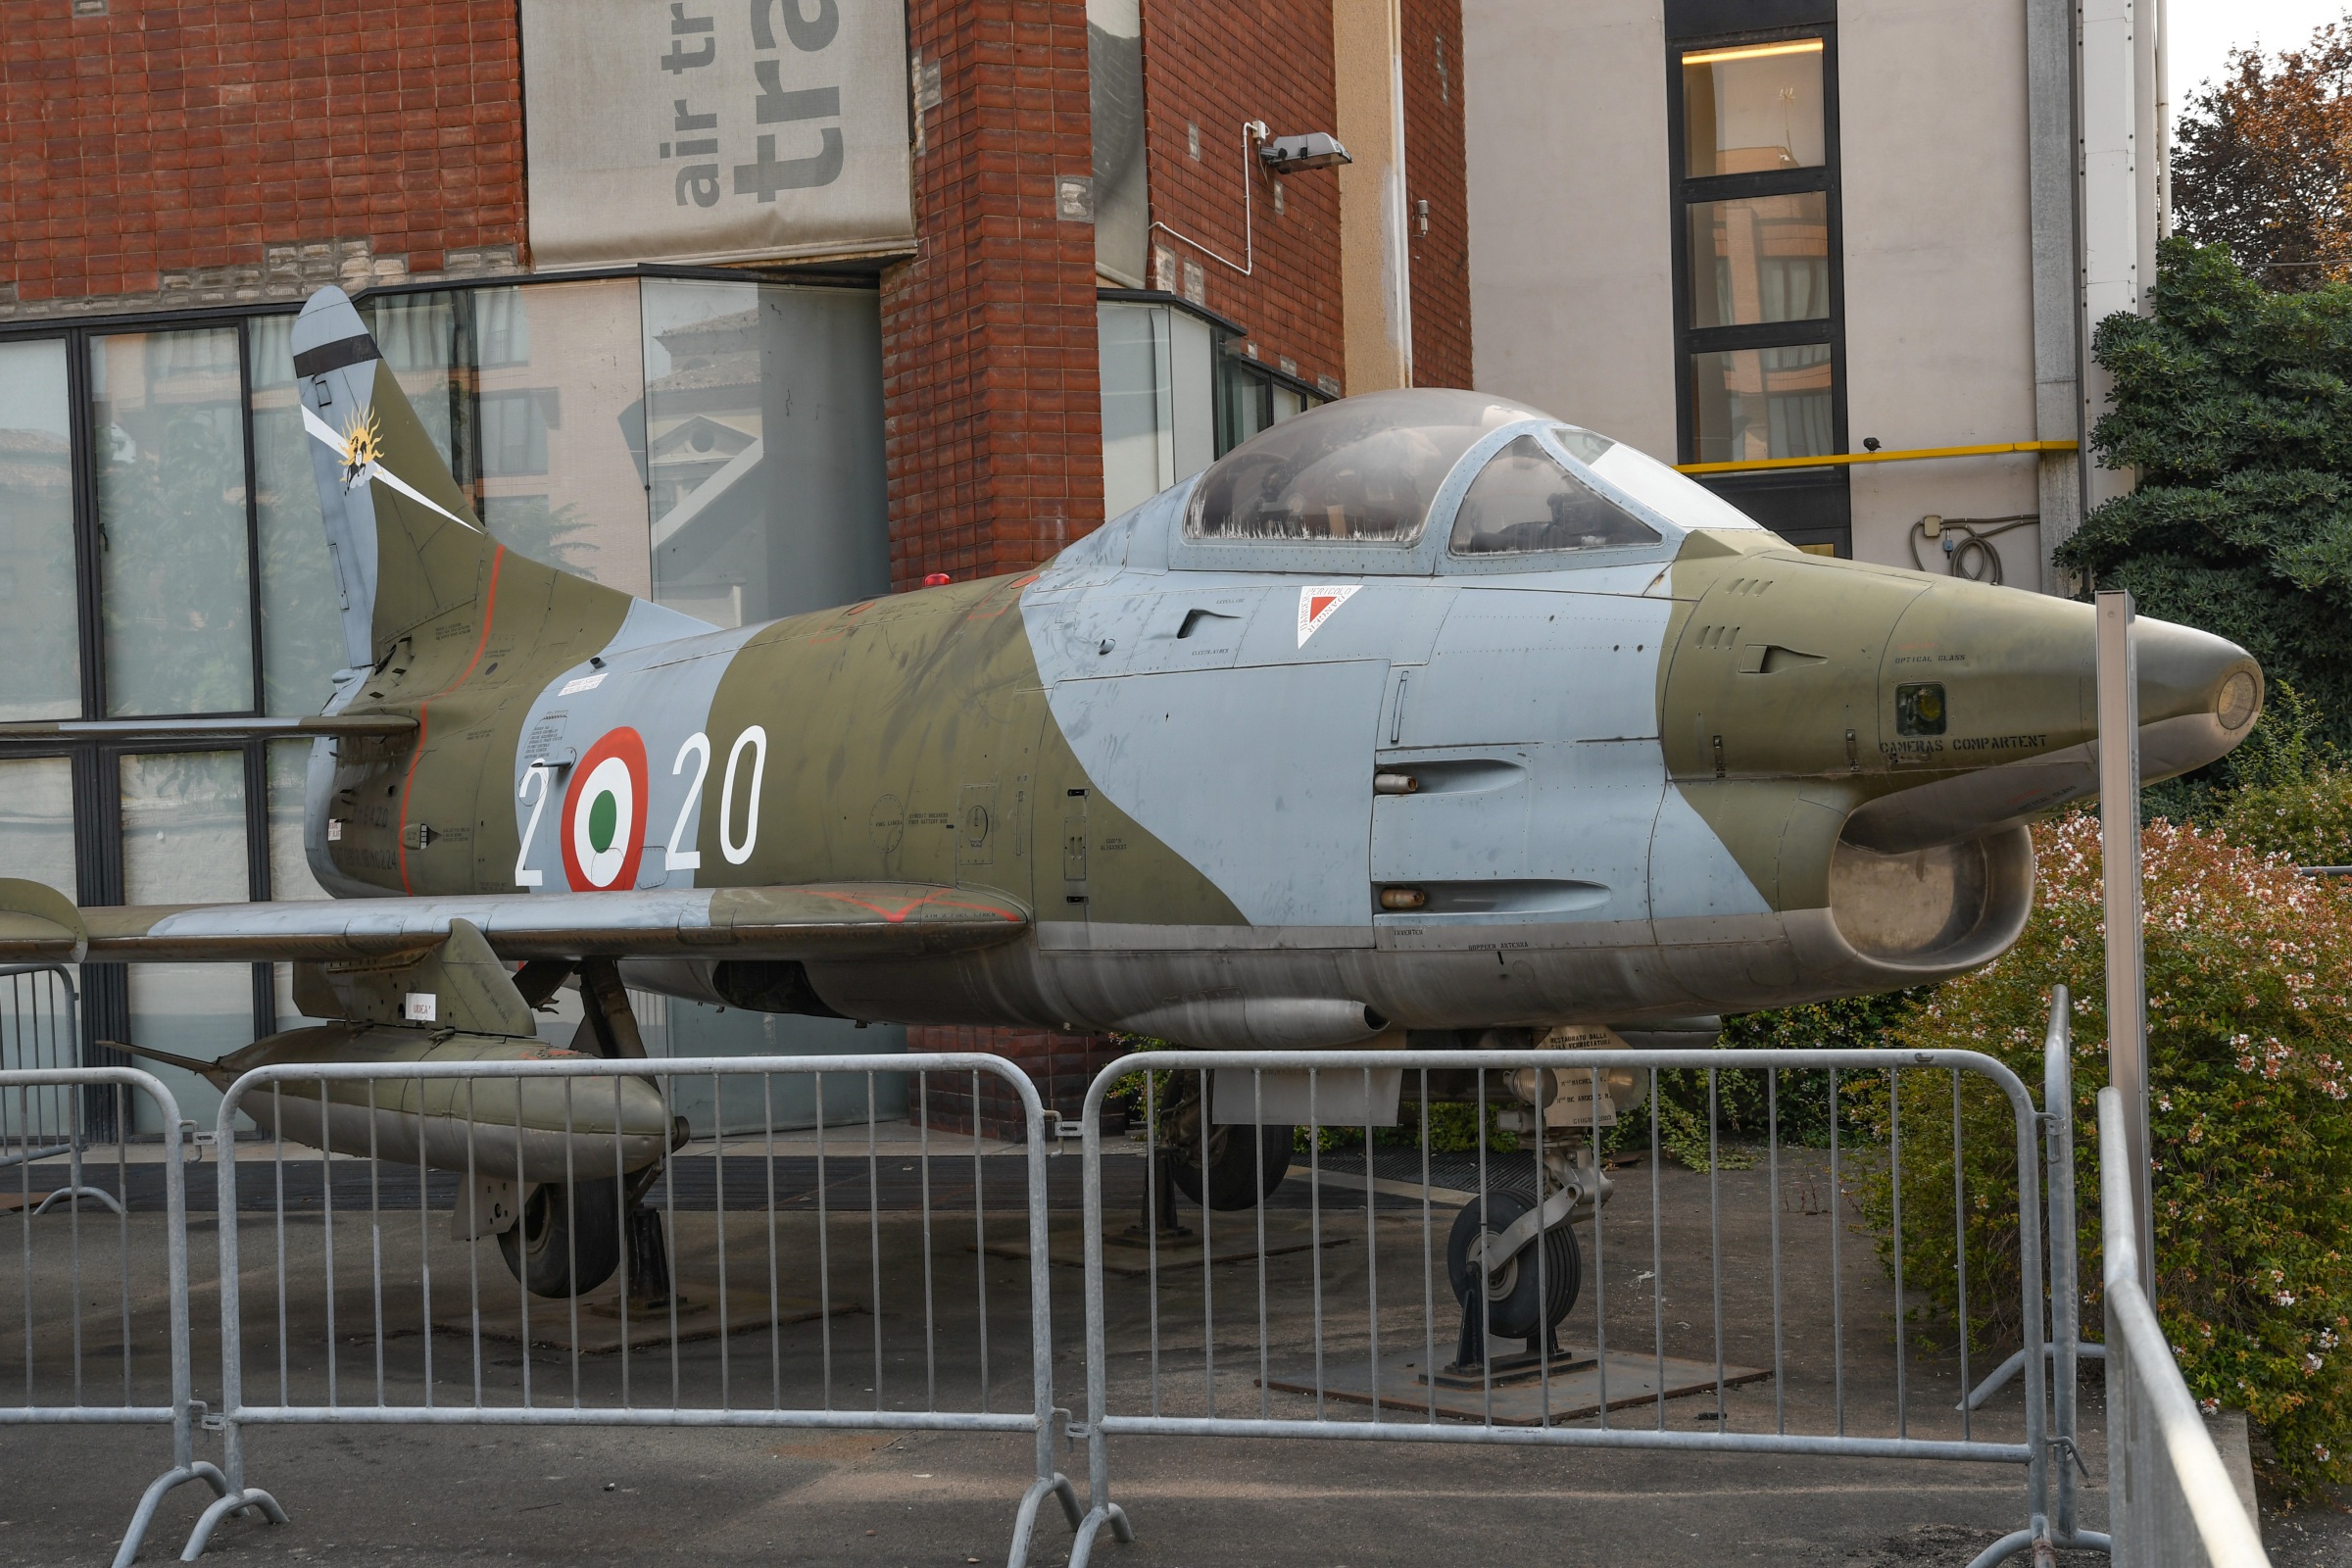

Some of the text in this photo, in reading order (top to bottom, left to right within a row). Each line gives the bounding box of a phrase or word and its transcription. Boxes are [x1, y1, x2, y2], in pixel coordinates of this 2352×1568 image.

[660, 2, 720, 208] air tr
[1894, 655, 1932, 664] OPTICAL
[1880, 734, 2047, 754] CAMERAS COMPARTENT
[665, 725, 767, 870] 20
[1549, 1034, 1587, 1044] RESTAURATO
